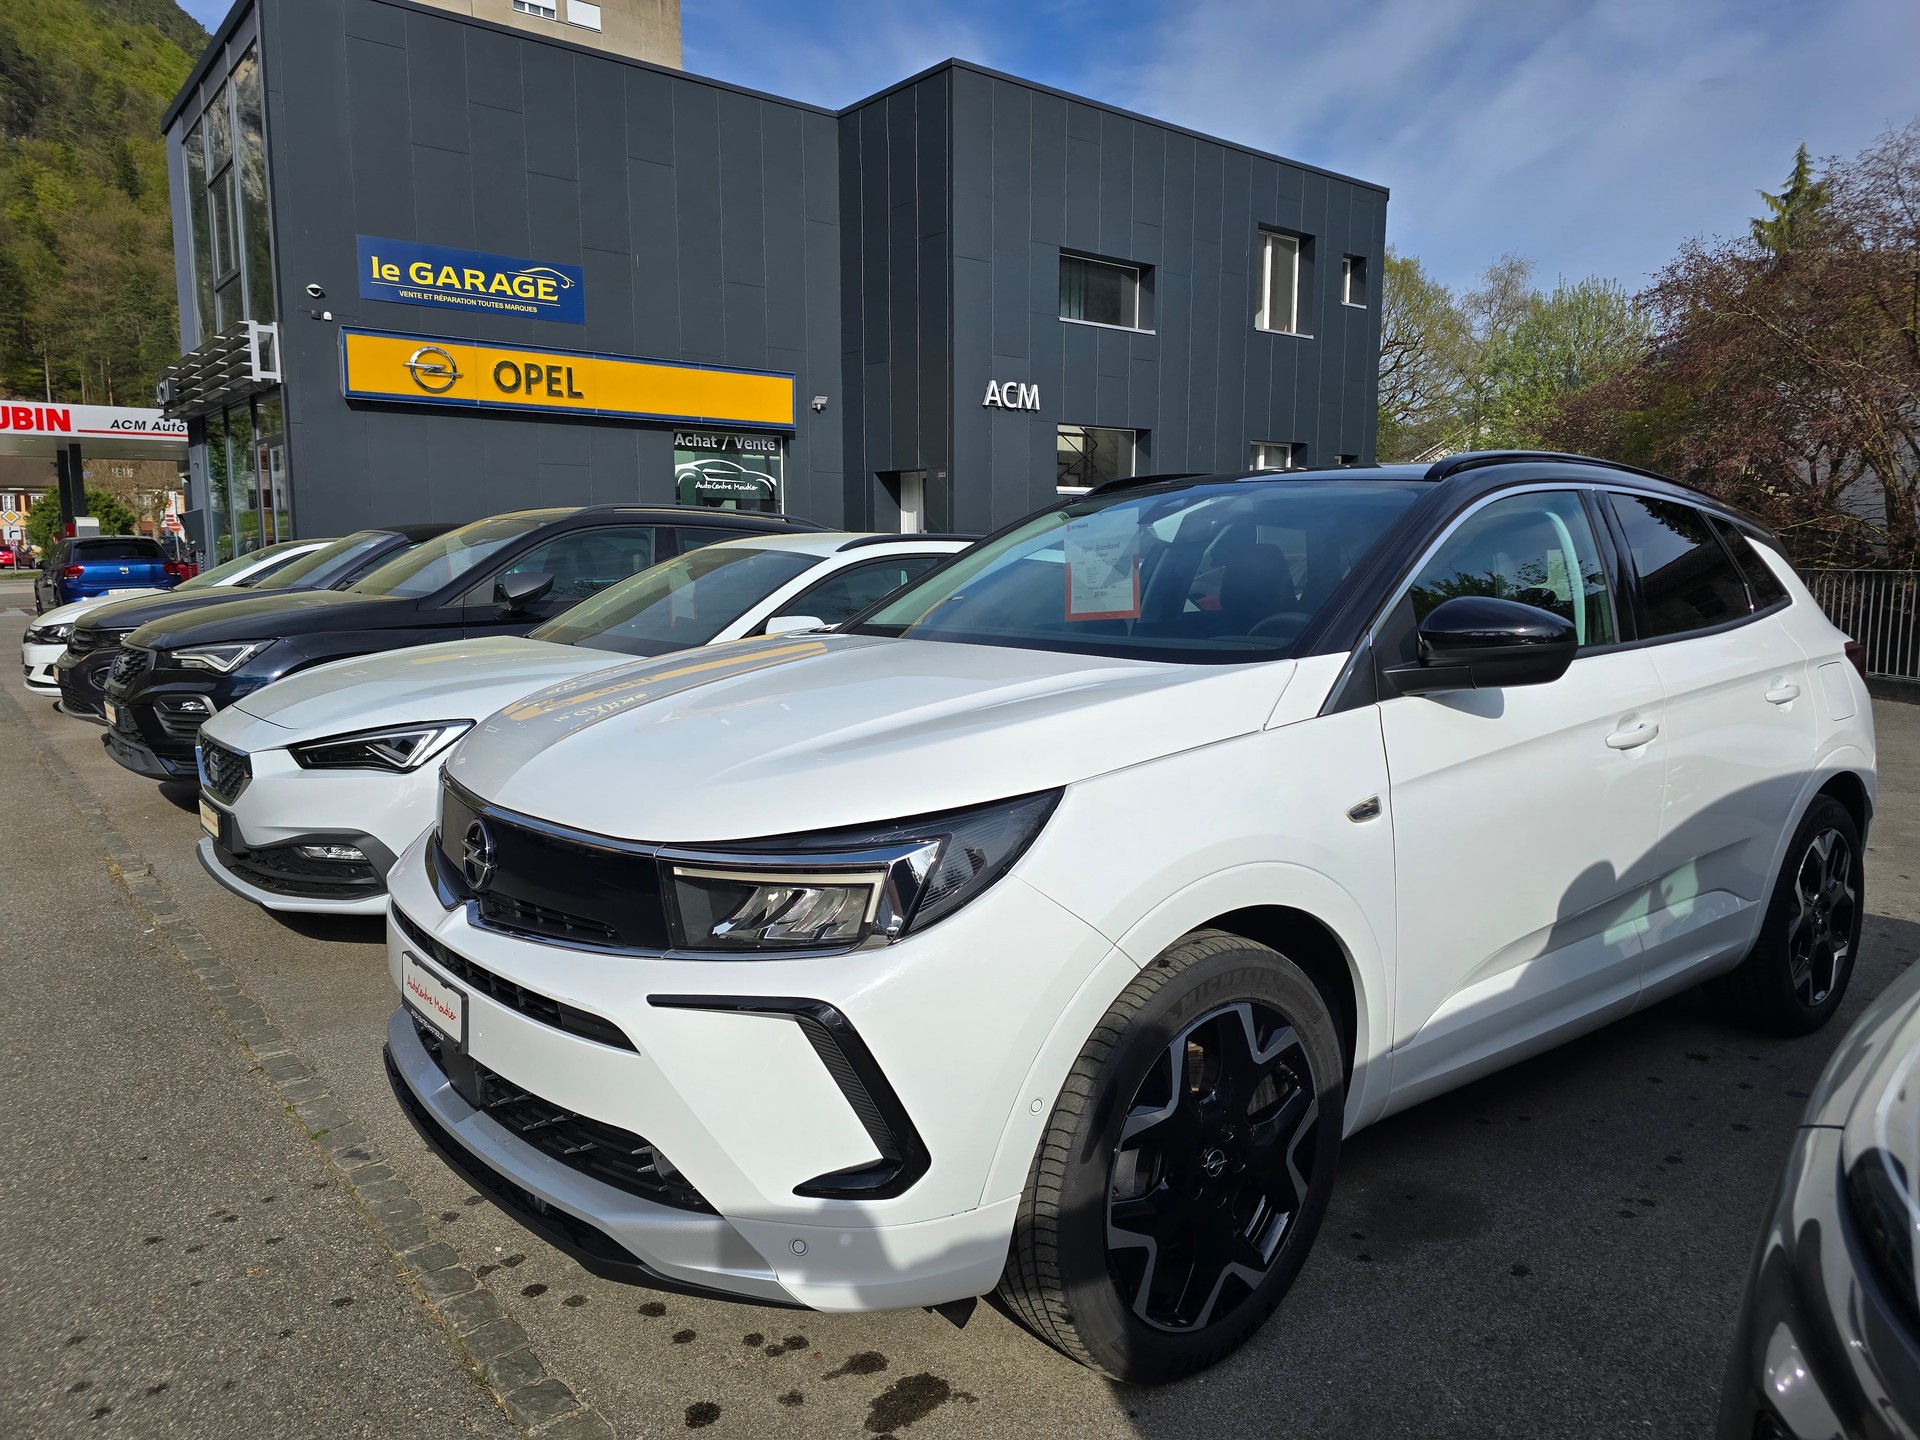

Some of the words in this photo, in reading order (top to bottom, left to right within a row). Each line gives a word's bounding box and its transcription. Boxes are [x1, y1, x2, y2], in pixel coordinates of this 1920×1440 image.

[370, 256, 400, 281] le
[409, 262, 558, 301] GARAGE
[398, 290, 422, 299] VENTE
[433, 294, 477, 306] RÉPARATION
[477, 301, 504, 309] TOUTES
[504, 304, 538, 313] MARQUES
[494, 360, 584, 399] OPEL
[982, 380, 1040, 410] ACM
[110, 419, 147, 431] ACM
[151, 421, 188, 432] Auto
[674, 433, 718, 448] Achat
[721, 436, 729, 451] /
[734, 437, 776, 451] Vente
